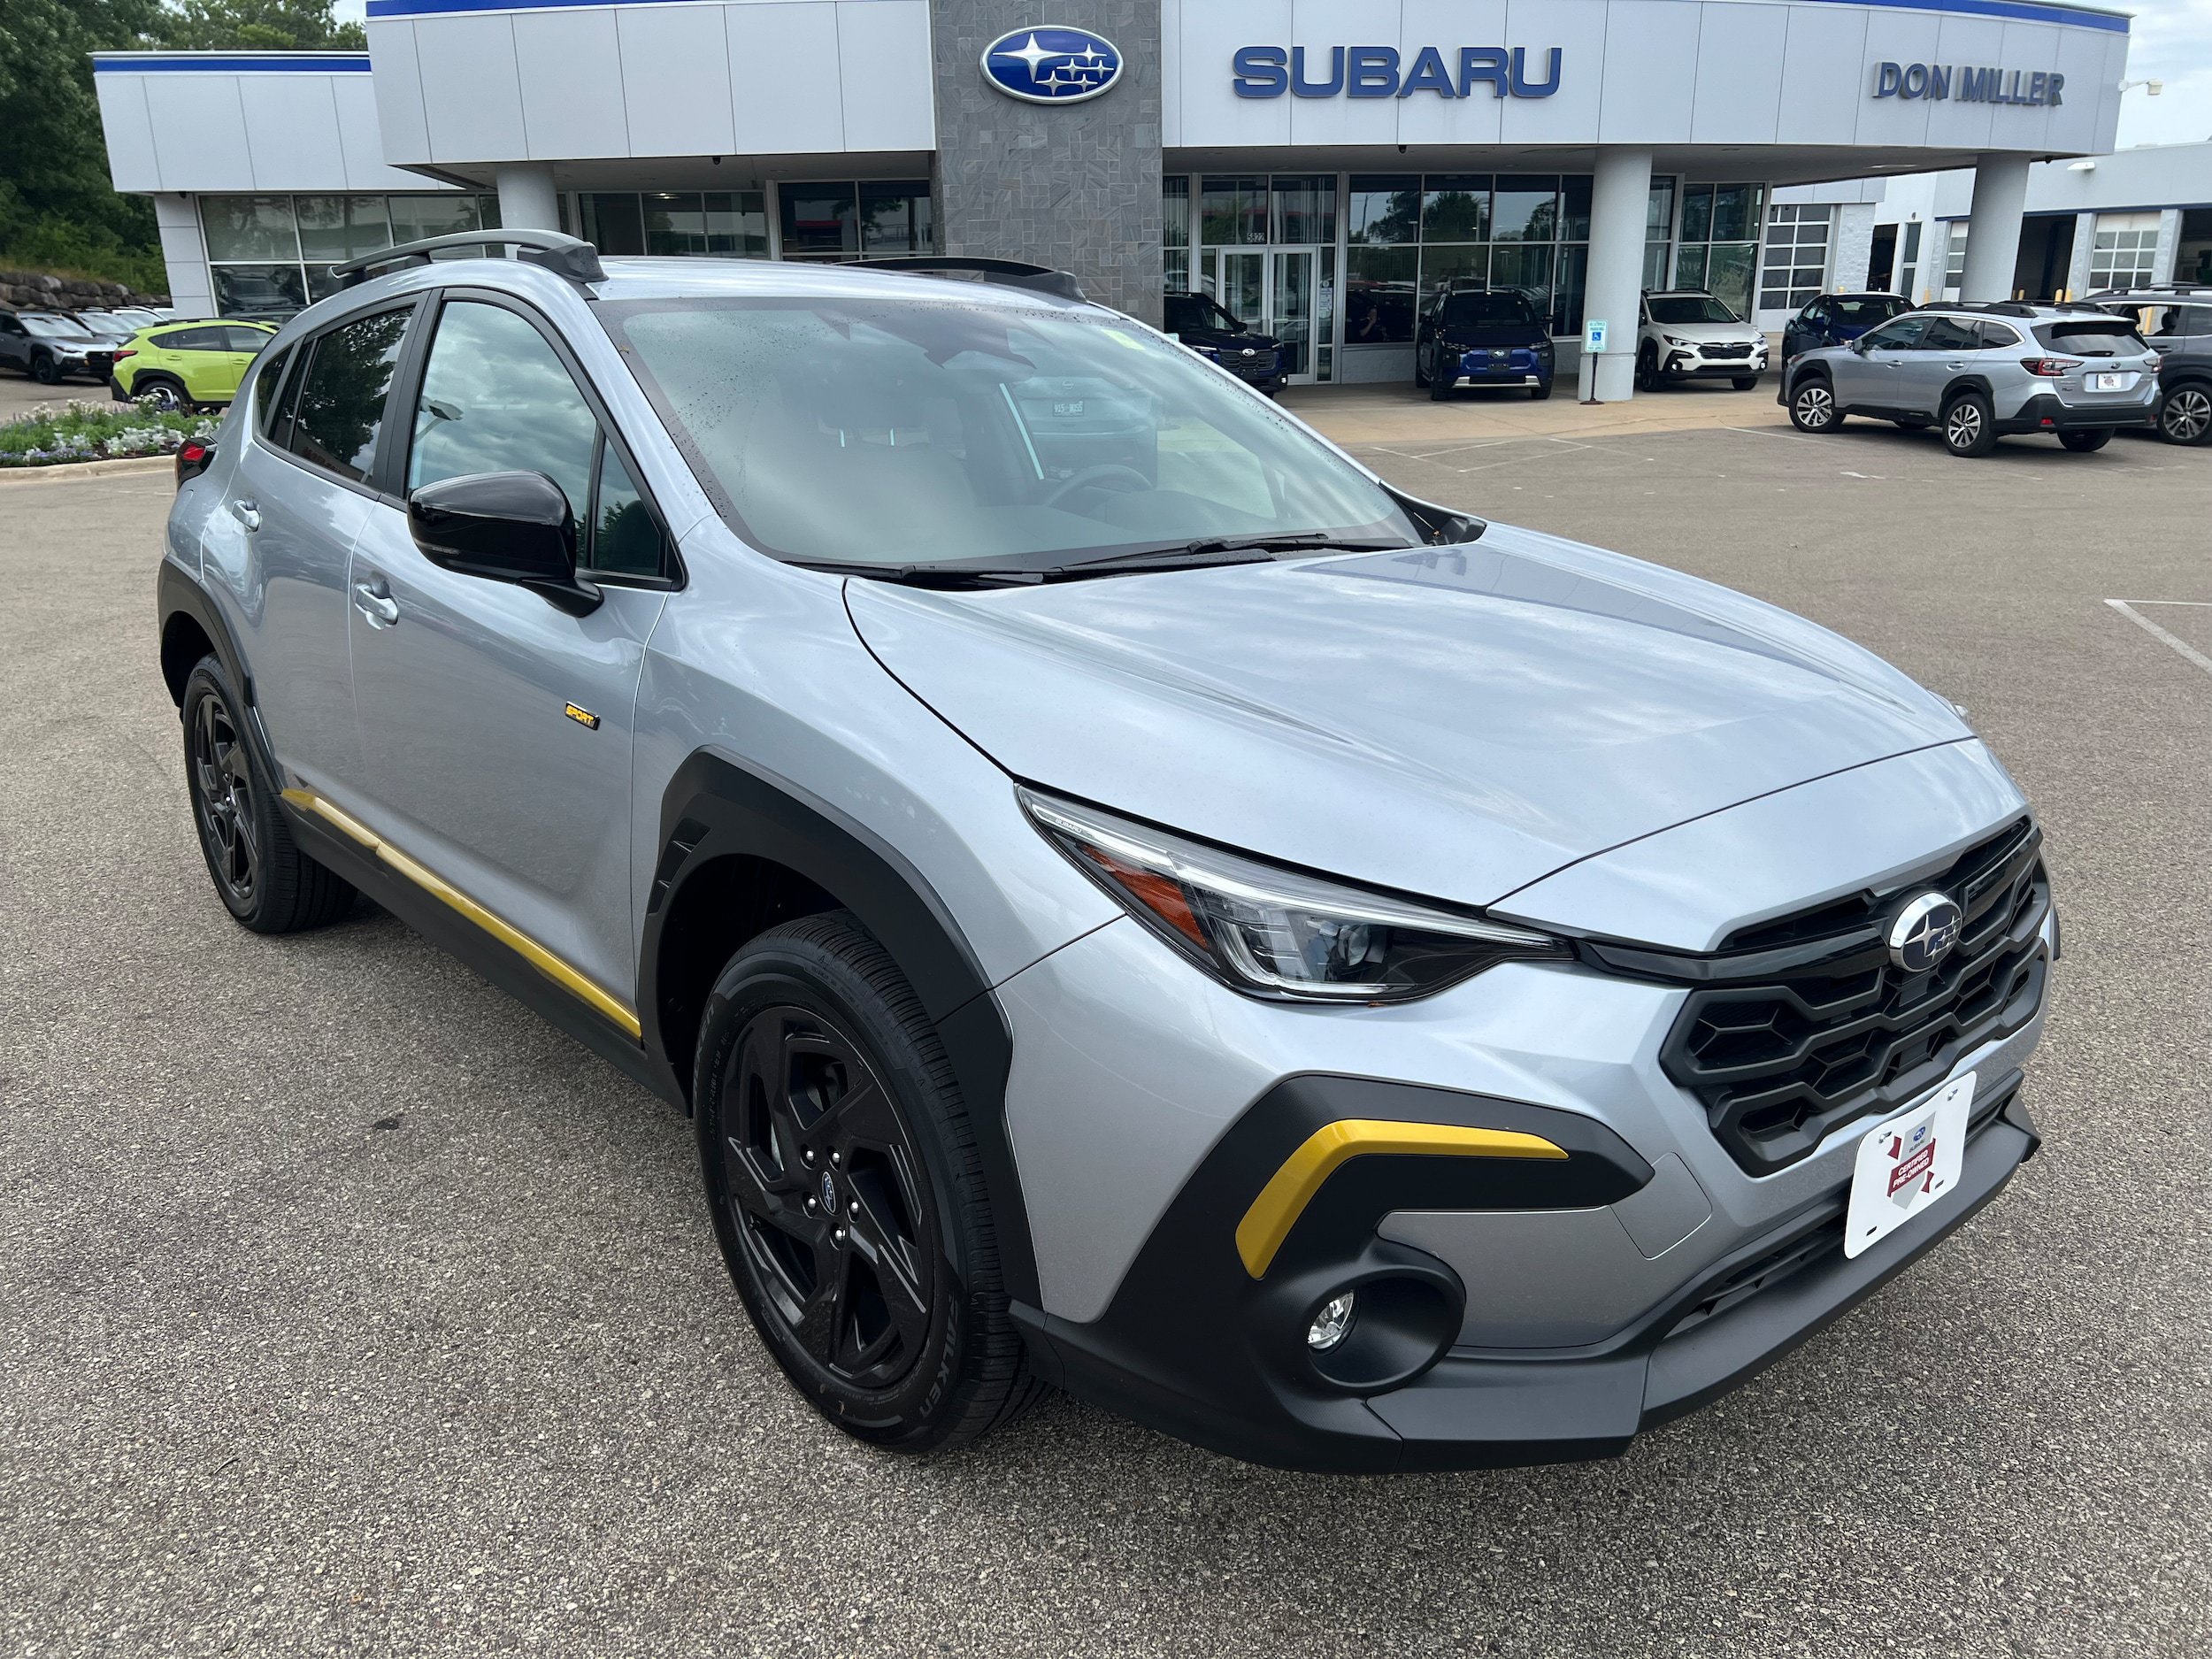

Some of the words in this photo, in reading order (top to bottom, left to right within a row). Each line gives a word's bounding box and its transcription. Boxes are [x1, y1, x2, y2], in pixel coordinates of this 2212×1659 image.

[1233, 46, 1562, 98] SUBARU
[1873, 61, 1952, 100] DON
[1955, 66, 2064, 106] MILLER
[566, 705, 595, 726] SPORT
[1055, 818, 1082, 833] SUBARU
[1892, 1156, 1931, 1188] PRE-OWNED
[1898, 1149, 1929, 1176] CERTIFIED
